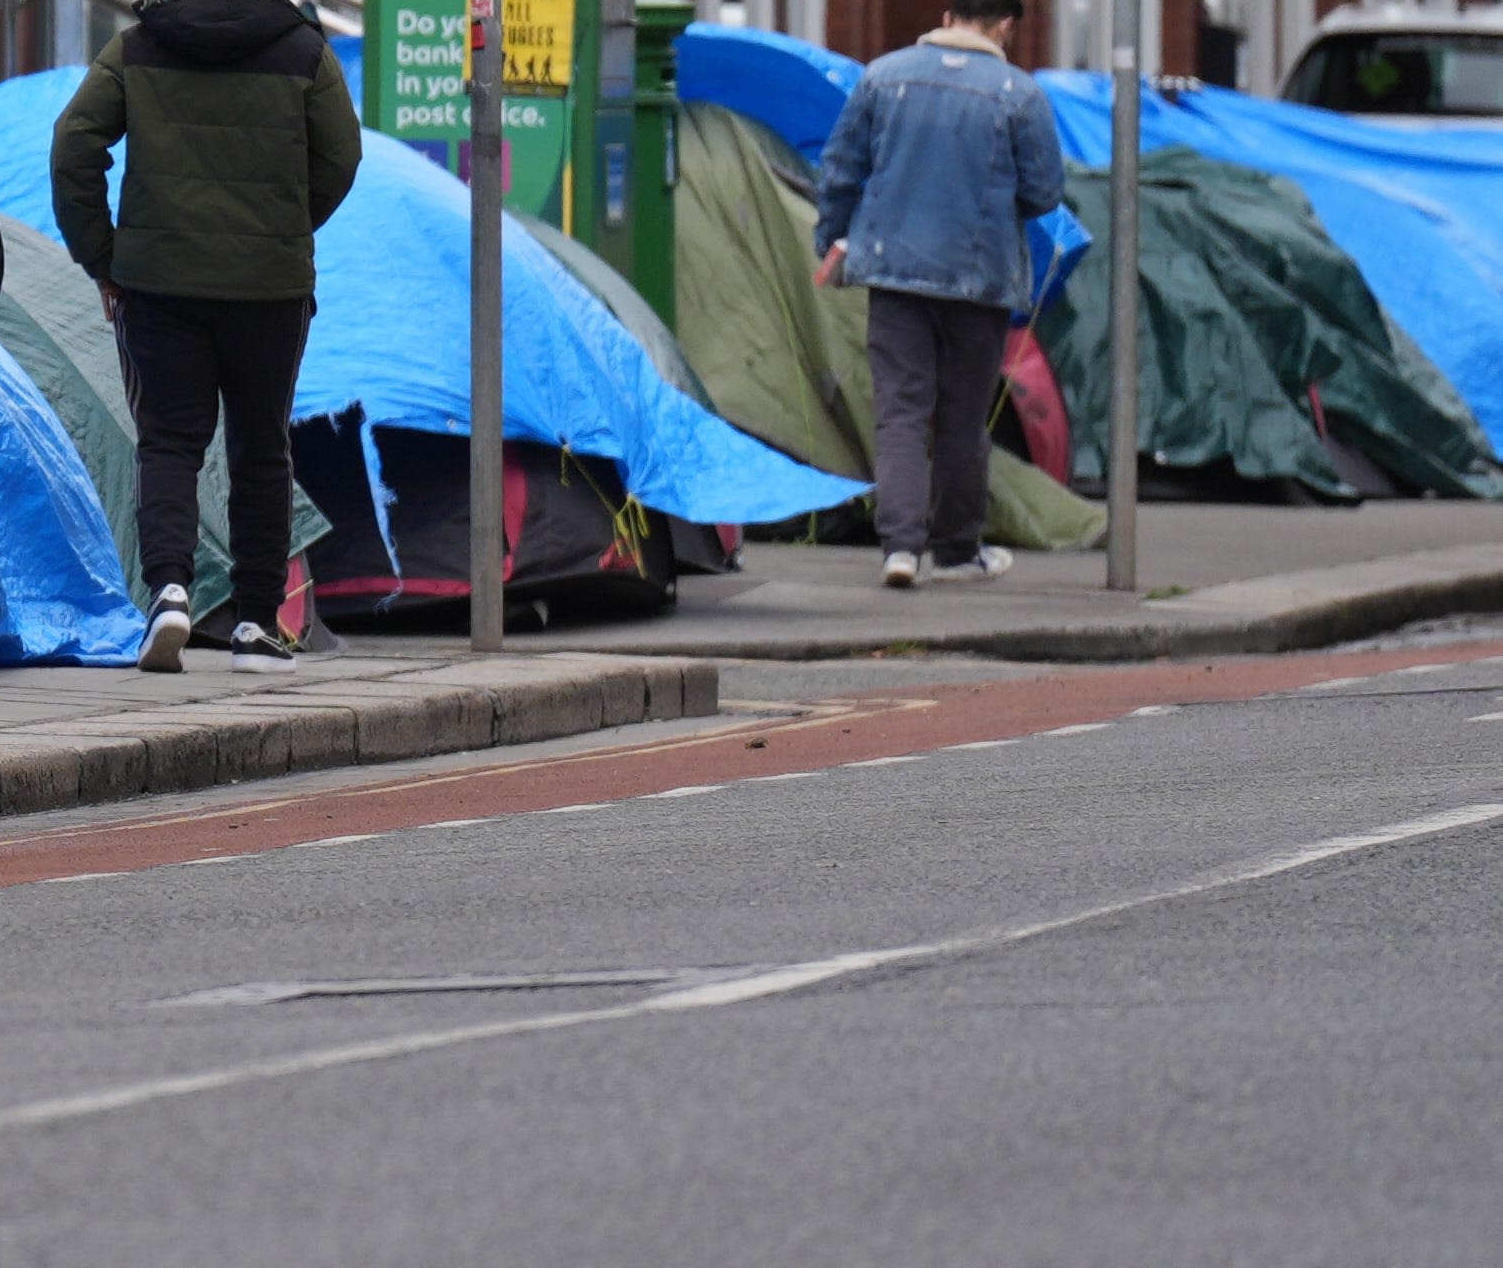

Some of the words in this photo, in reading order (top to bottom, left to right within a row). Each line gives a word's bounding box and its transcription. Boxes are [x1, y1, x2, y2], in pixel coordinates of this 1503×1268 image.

[397, 9, 436, 36] Do
[396, 70, 420, 97] in
[396, 101, 457, 130] post
